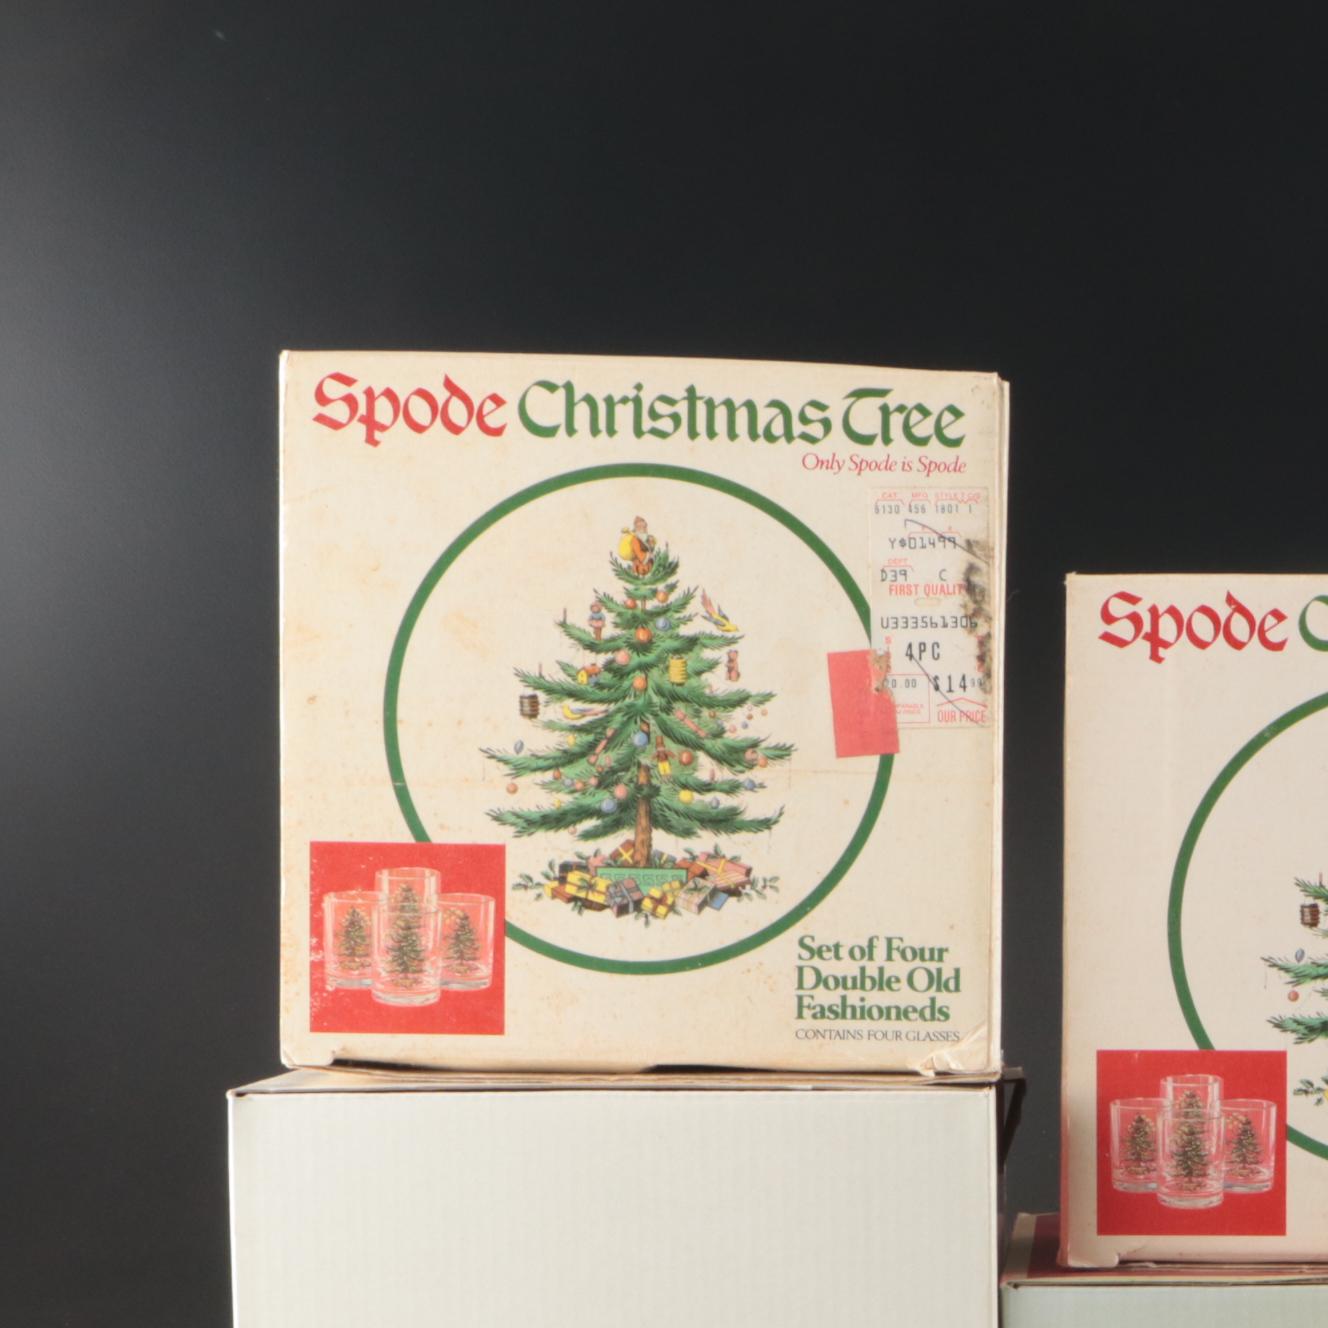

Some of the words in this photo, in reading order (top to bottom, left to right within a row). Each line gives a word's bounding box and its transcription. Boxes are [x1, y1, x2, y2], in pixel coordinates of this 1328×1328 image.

[312, 371, 507, 448] Spode
[517, 380, 831, 445] Christmas
[841, 388, 966, 449] Tree
[802, 452, 845, 475] Only
[848, 453, 898, 476] Spode
[901, 456, 913, 473] is
[917, 454, 967, 478] Spode
[889, 584, 919, 597] FIRST
[1099, 590, 1289, 664] Spode
[937, 710, 956, 723] OUR
[959, 711, 986, 724] PRICE
[798, 934, 844, 962] Set
[848, 935, 879, 962] of
[884, 936, 949, 963] Four
[795, 965, 901, 992] Double
[906, 966, 961, 993] Old
[795, 994, 950, 1022] Fashioneds
[795, 1029, 863, 1041] CONTAINS
[868, 1030, 902, 1041] FOUR
[905, 1031, 960, 1042] GLASSES
